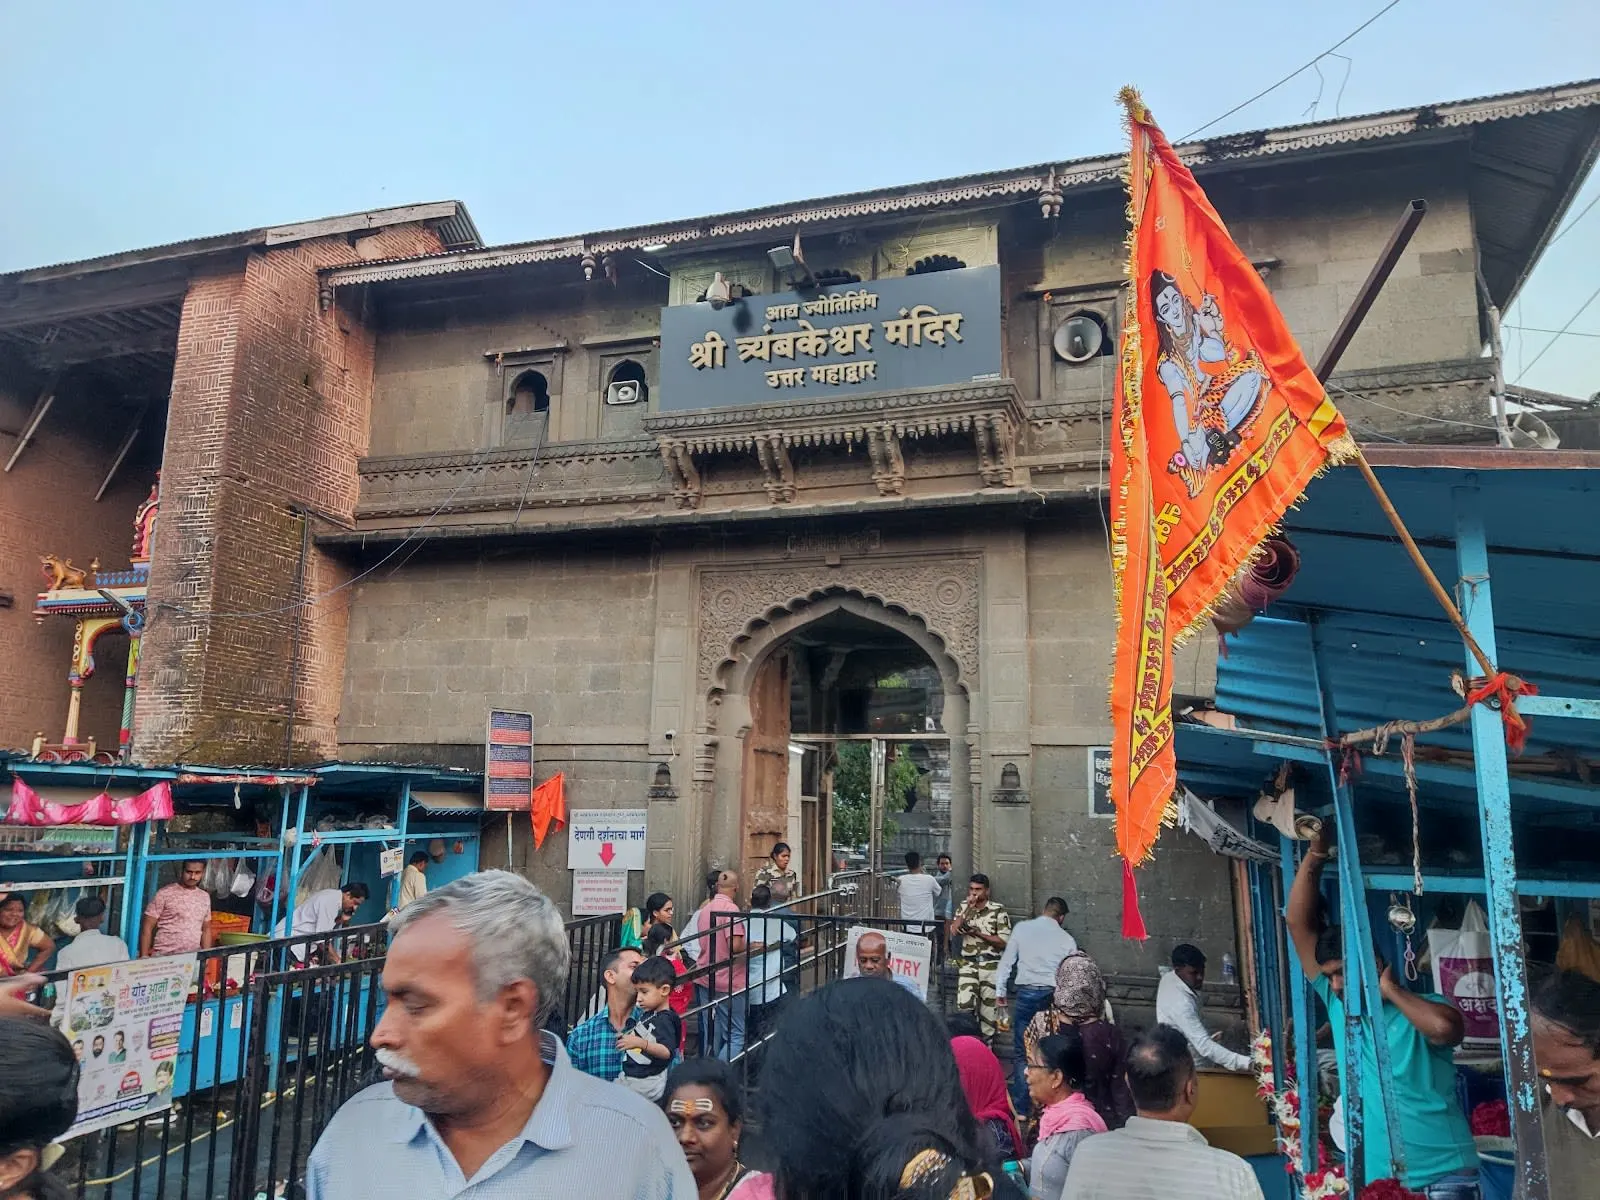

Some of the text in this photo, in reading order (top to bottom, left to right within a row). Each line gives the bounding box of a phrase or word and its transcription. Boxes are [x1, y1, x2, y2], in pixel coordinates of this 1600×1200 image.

[765, 289, 878, 322] आद्य ज्योतिर्लिंग
[687, 304, 964, 369] श्री त्र्यंबकेश्वर मंदिर
[765, 360, 877, 388] उत्तर महाद्वार
[574, 826, 645, 843] देणगी दर्शनाचा मार्ग
